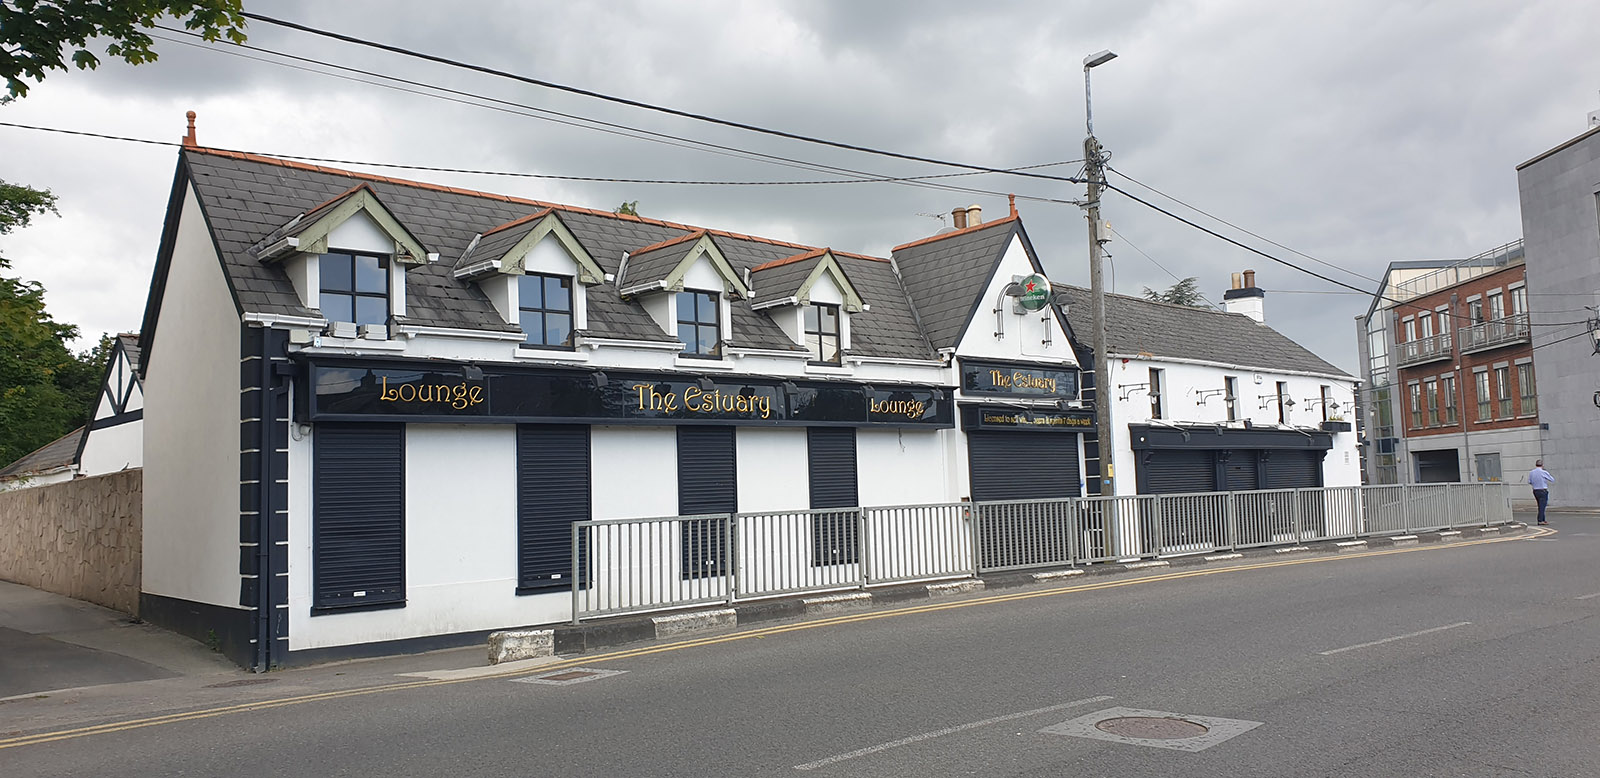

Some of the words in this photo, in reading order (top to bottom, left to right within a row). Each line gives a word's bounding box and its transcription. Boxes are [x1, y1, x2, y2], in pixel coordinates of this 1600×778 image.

[380, 376, 484, 410] Lounge
[989, 369, 1012, 388] The
[1013, 372, 1056, 393] Estuary
[632, 383, 678, 414] The
[684, 386, 770, 419] Estuary
[870, 397, 924, 419] Lounge
